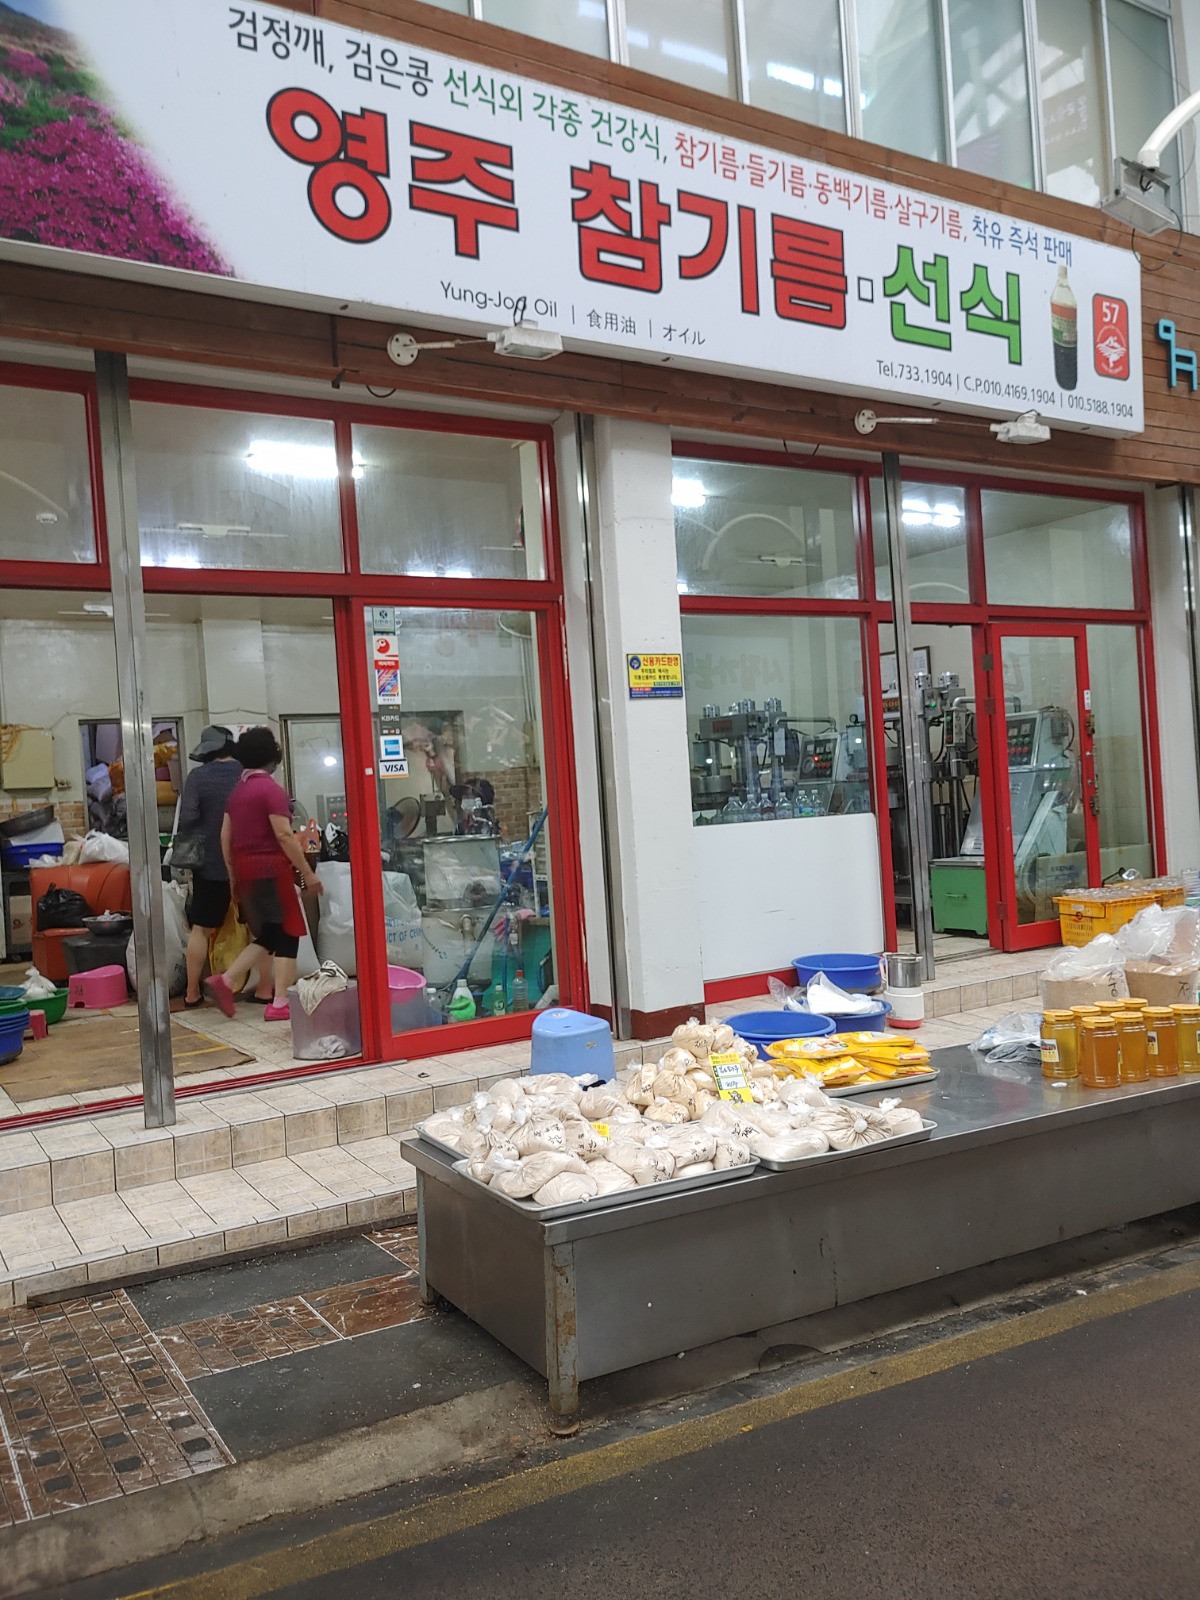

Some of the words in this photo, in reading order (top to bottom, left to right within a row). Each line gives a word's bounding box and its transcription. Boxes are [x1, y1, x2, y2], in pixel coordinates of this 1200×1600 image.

[228, 7, 334, 74] 검정깨,
[345, 38, 434, 98] 검은콩
[443, 67, 524, 122] 선식외
[532, 91, 582, 139] 각종
[590, 107, 668, 164] 건강식,
[971, 215, 1004, 249] 착유
[1008, 224, 1040, 260] 즉석
[1043, 236, 1073, 268] 판매
[265, 87, 520, 260] 영주
[569, 161, 848, 330] 참기름
[883, 244, 1022, 366] 선식
[534, 299, 558, 318] Oil
[1102, 301, 1119, 324] 57
[587, 308, 637, 336] 食用油
[663, 324, 706, 346] オイル
[876, 360, 952, 388] Tel.733.1904
[1068, 394, 1134, 419] 010.5188.1904
[642, 656, 679, 667] 신용카드환영
[384, 763, 405, 773] VISA
